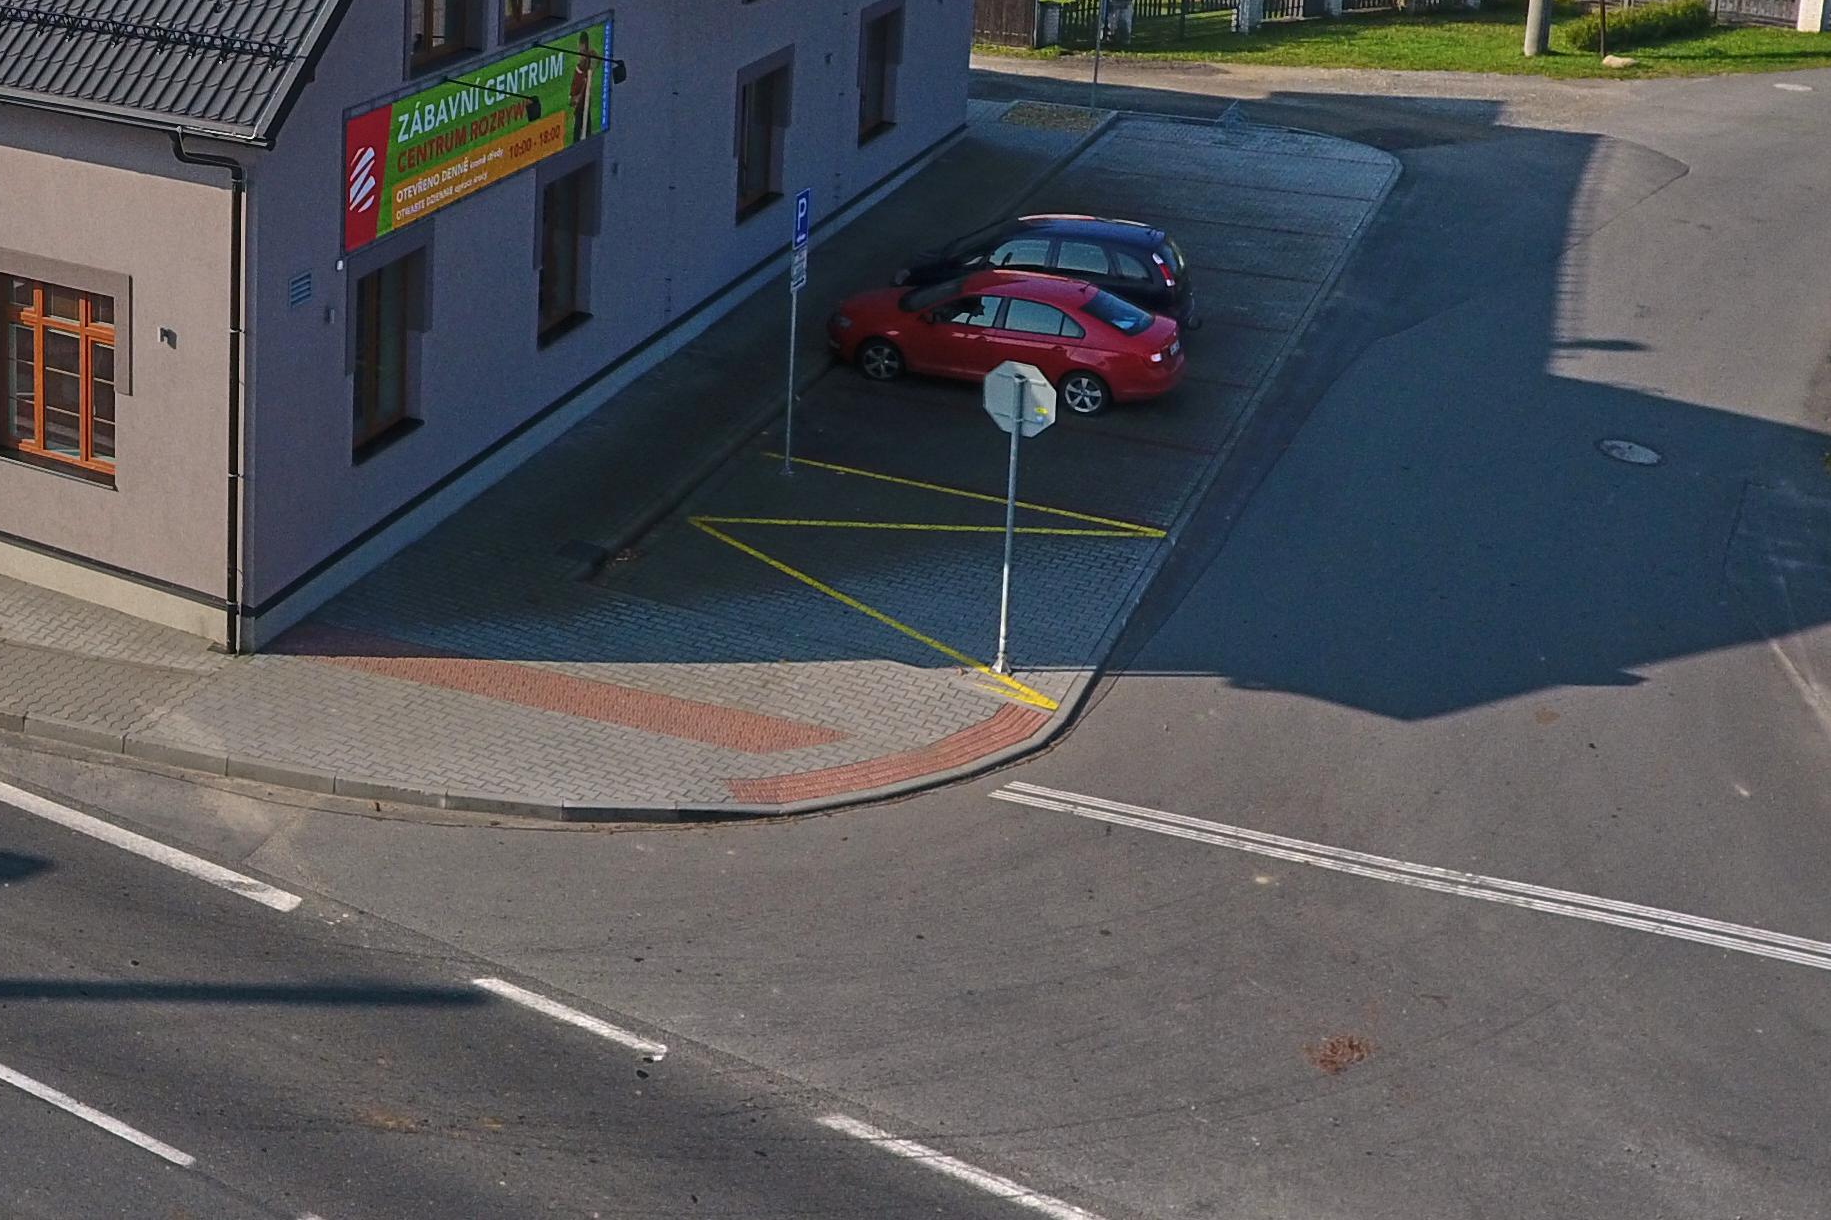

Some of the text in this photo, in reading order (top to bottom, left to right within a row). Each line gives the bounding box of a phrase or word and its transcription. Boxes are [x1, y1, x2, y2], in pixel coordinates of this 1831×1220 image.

[397, 77, 480, 143] ZÁBAVNÍ
[483, 52, 565, 106] CENTRUM
[396, 173, 440, 203] OTEVŘENO
[441, 156, 469, 182] DENNĚ
[509, 137, 532, 158] 10:00
[539, 124, 561, 147] 18:00
[397, 100, 531, 173] CENTRUM ROZRYW
[797, 198, 807, 230] P
